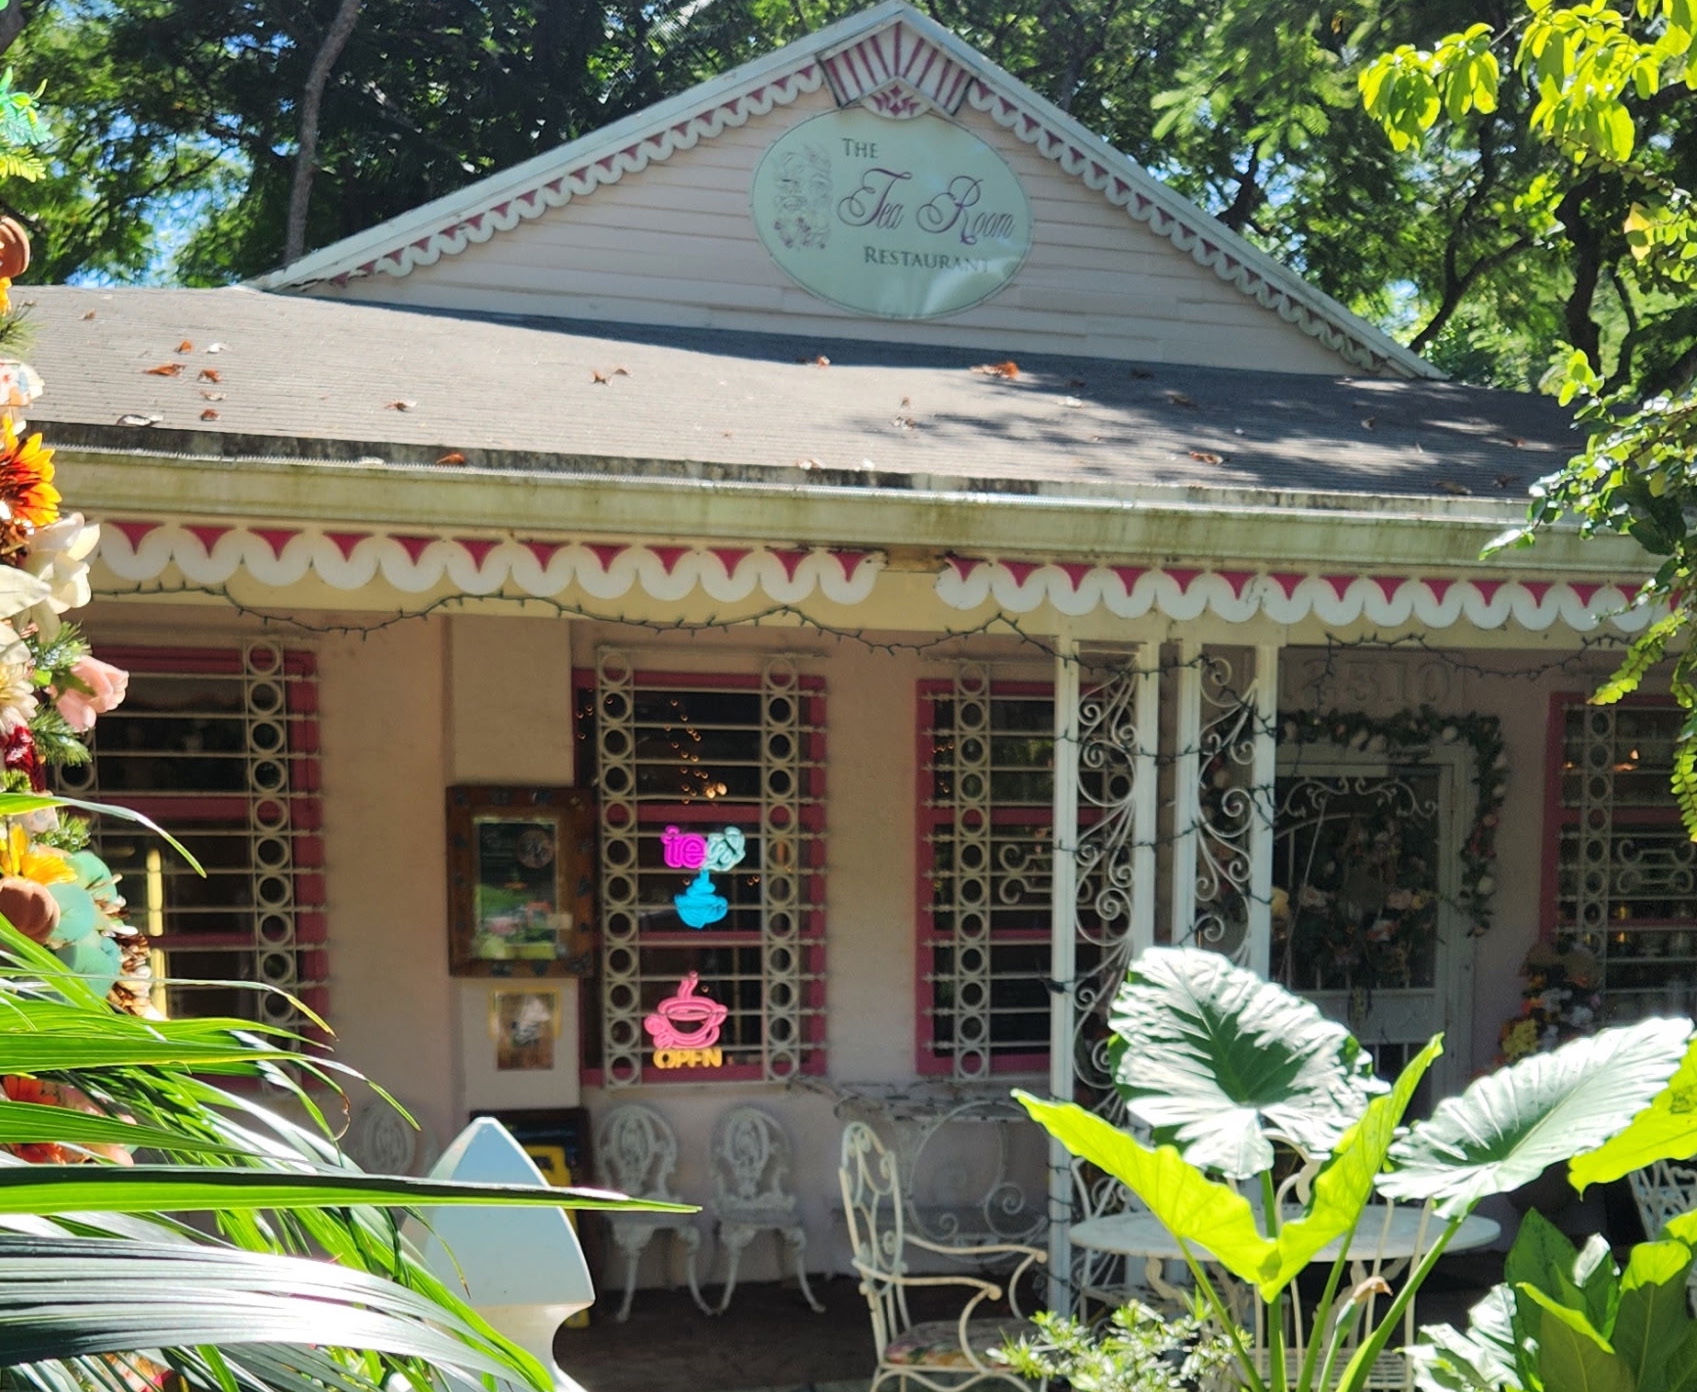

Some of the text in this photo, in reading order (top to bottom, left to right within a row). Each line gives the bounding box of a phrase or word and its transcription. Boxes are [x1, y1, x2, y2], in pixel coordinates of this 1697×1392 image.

[841, 137, 880, 159] THE
[837, 167, 1016, 246] Tea Room
[863, 246, 990, 273] RESTAURANT
[653, 1047, 722, 1069] OPEN
